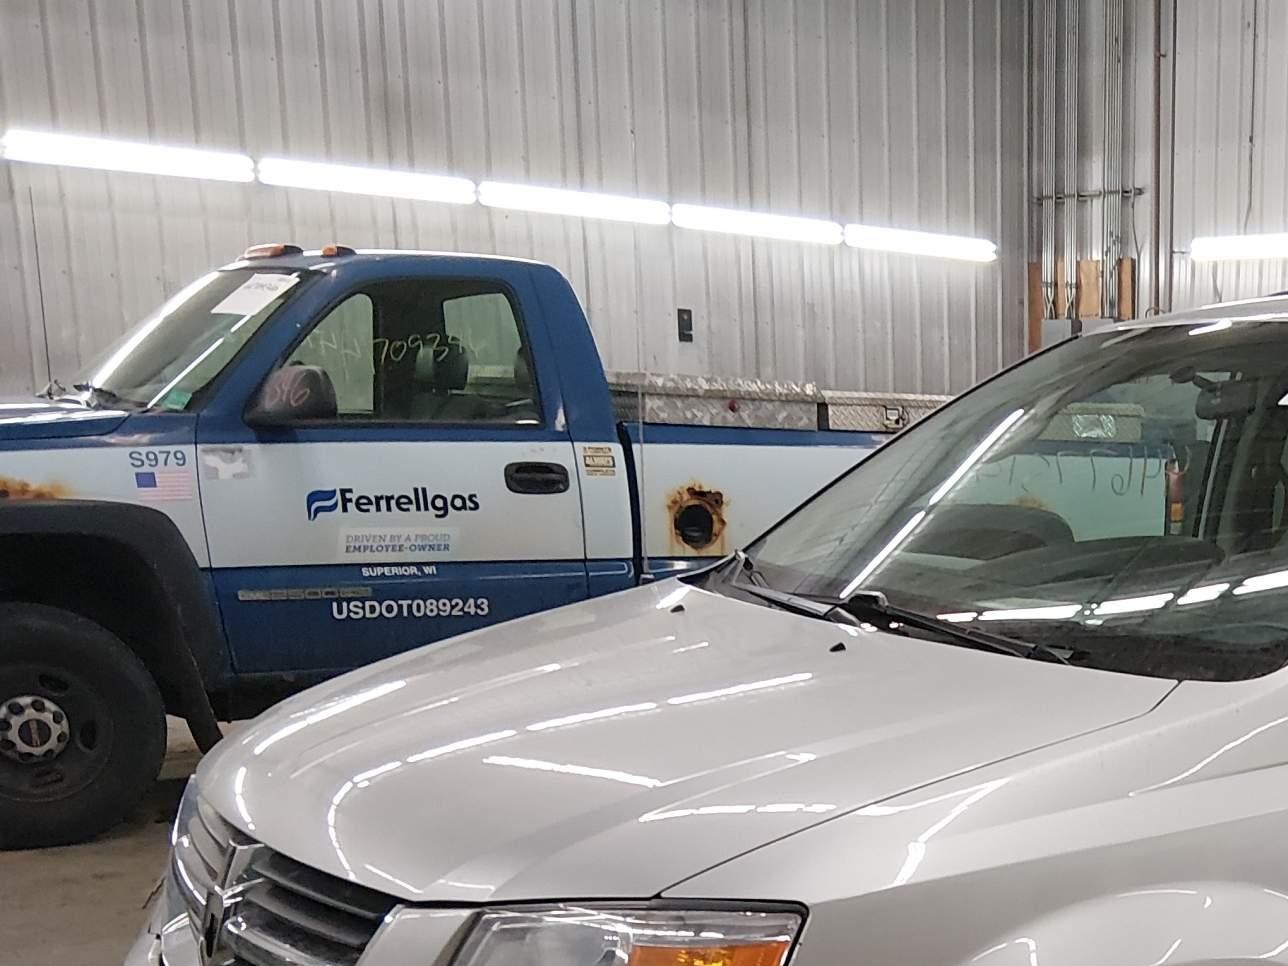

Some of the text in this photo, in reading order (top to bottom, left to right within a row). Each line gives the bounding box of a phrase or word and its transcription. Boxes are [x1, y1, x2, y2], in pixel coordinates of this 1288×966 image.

[128, 450, 187, 468] S979
[339, 487, 480, 518] Ferrellgas
[345, 533, 451, 544] DRIVEN BY A PROUD
[344, 543, 450, 553] EMPLOYEE-OWNER
[361, 565, 437, 576] SUPERIOR, WI
[332, 599, 489, 619] USDOT089243
